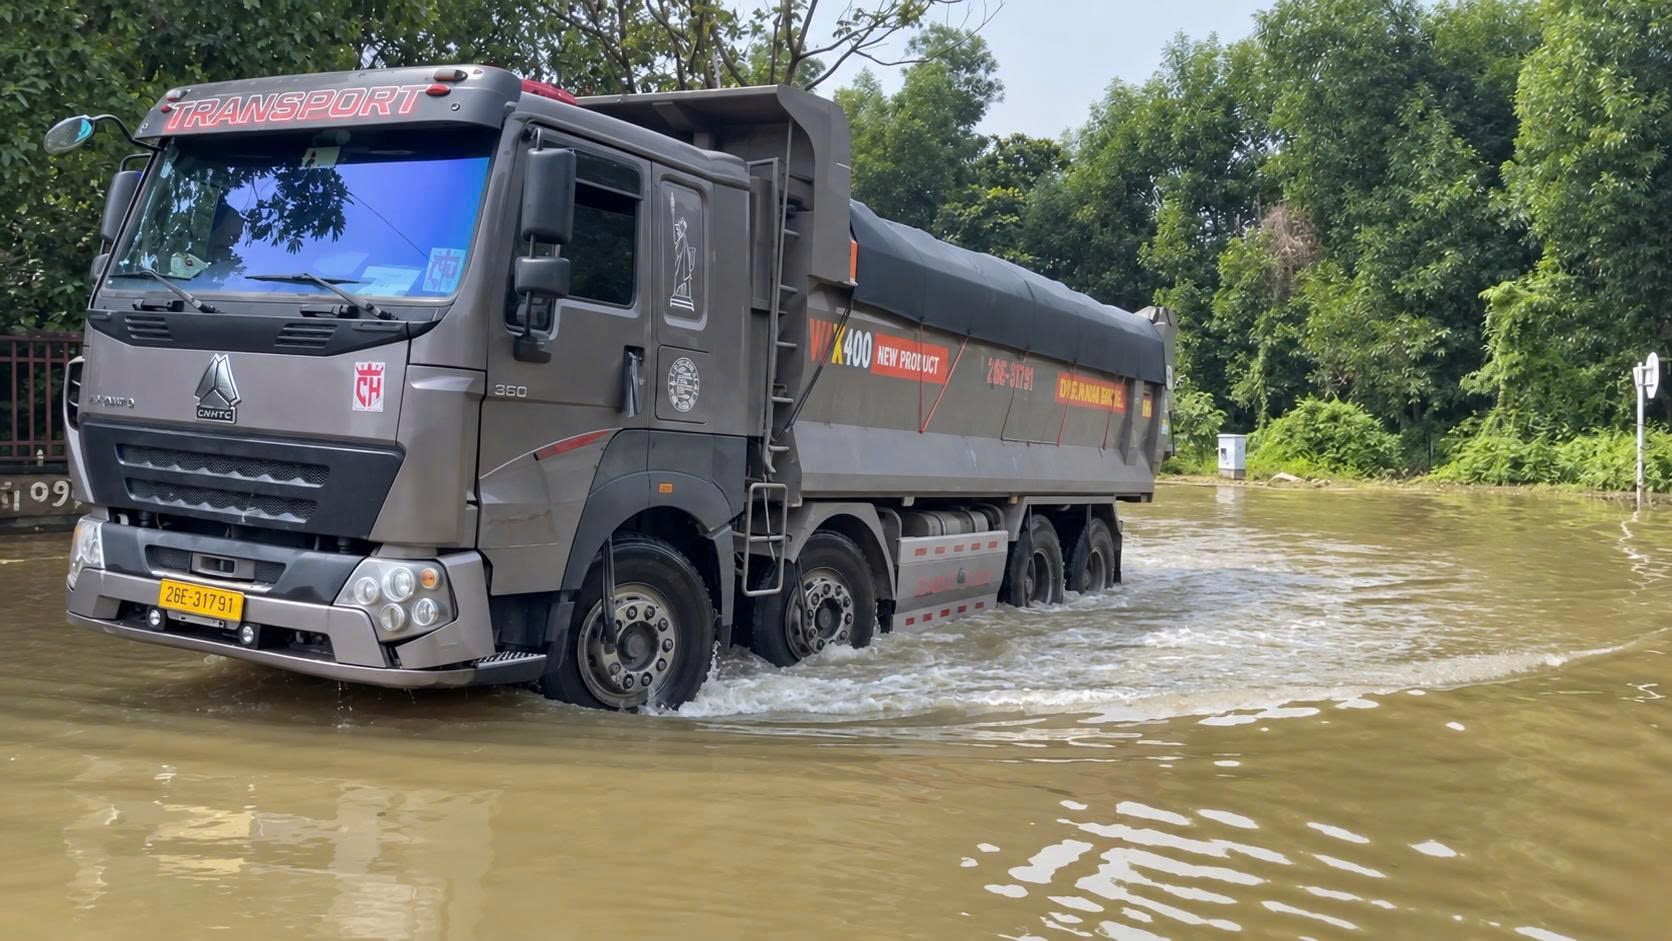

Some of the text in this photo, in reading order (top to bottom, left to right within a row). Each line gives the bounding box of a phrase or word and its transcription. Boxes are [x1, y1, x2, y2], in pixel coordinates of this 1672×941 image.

[168, 84, 427, 130] TRANSPORT
[877, 345, 940, 375] NEW PRODUCT
[356, 375, 382, 408] CH
[495, 384, 527, 398] 360
[197, 408, 232, 420] CNHTC
[165, 585, 233, 614] 26E-31791
